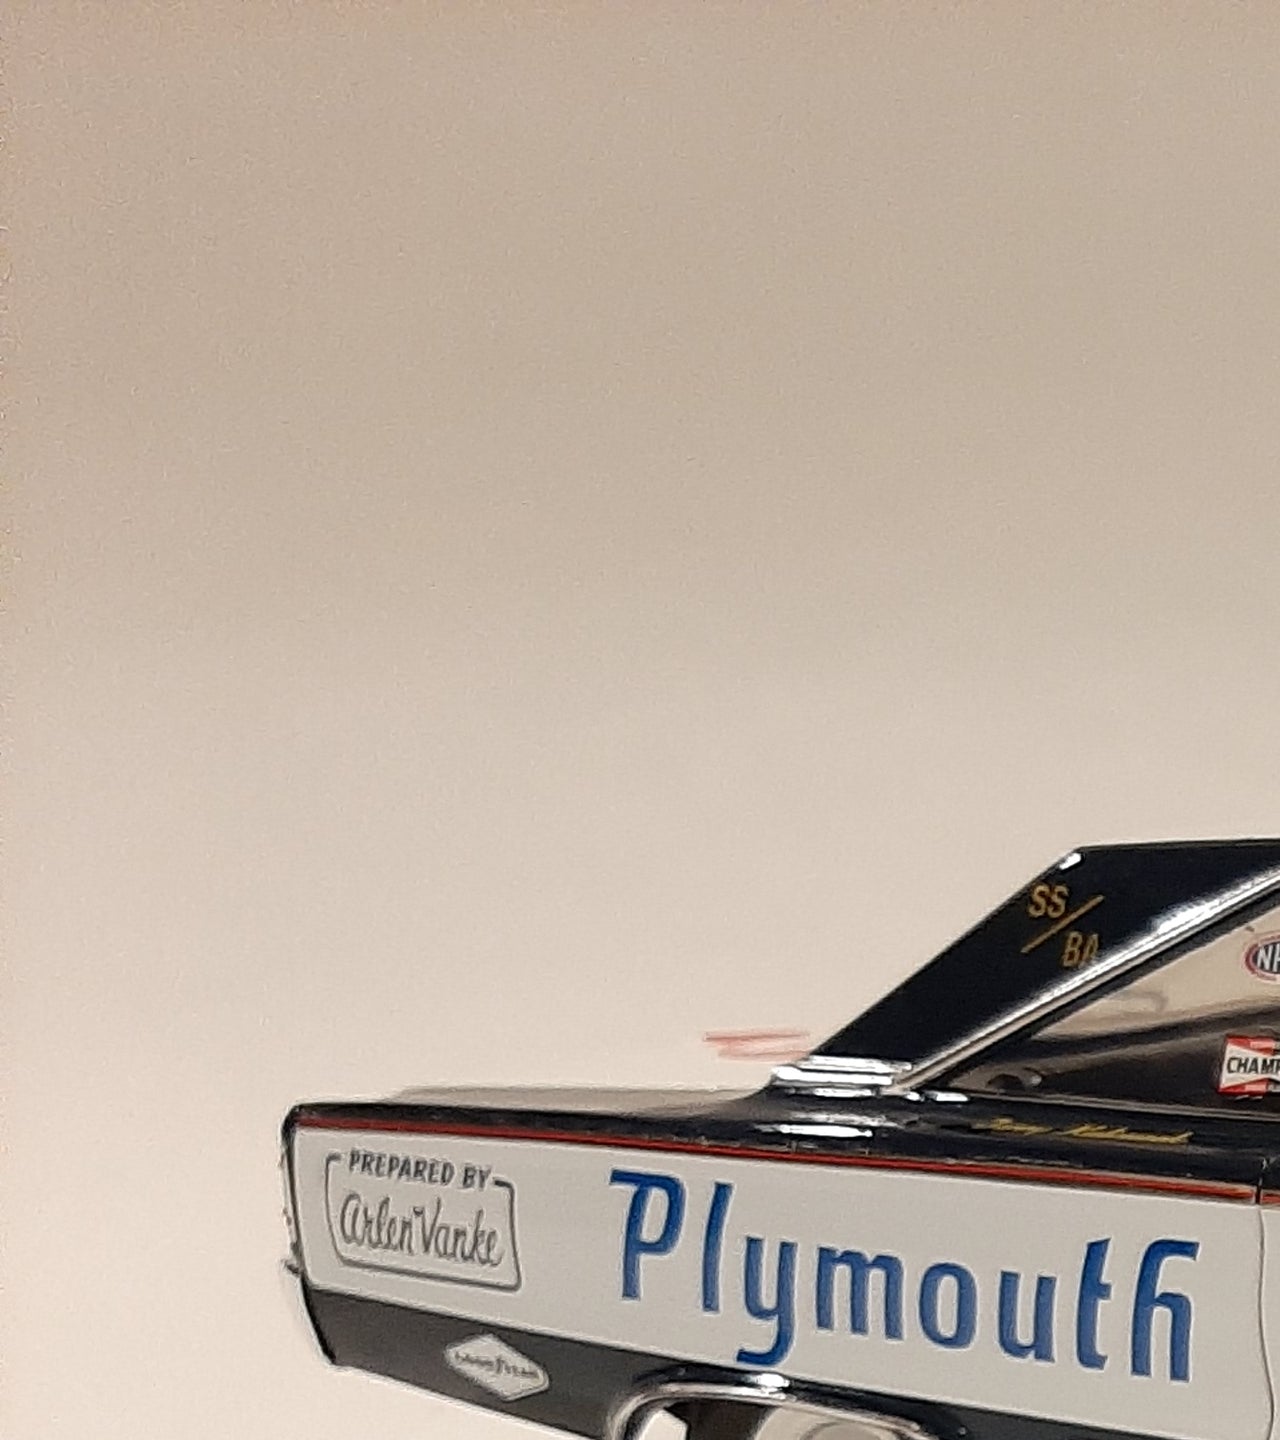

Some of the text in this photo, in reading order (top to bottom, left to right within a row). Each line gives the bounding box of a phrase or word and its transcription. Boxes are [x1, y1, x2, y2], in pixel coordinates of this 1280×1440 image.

[1027, 884, 1069, 918] SS
[350, 1149, 492, 1189] PREPARED BY
[609, 1168, 1199, 1383] Plymouth
